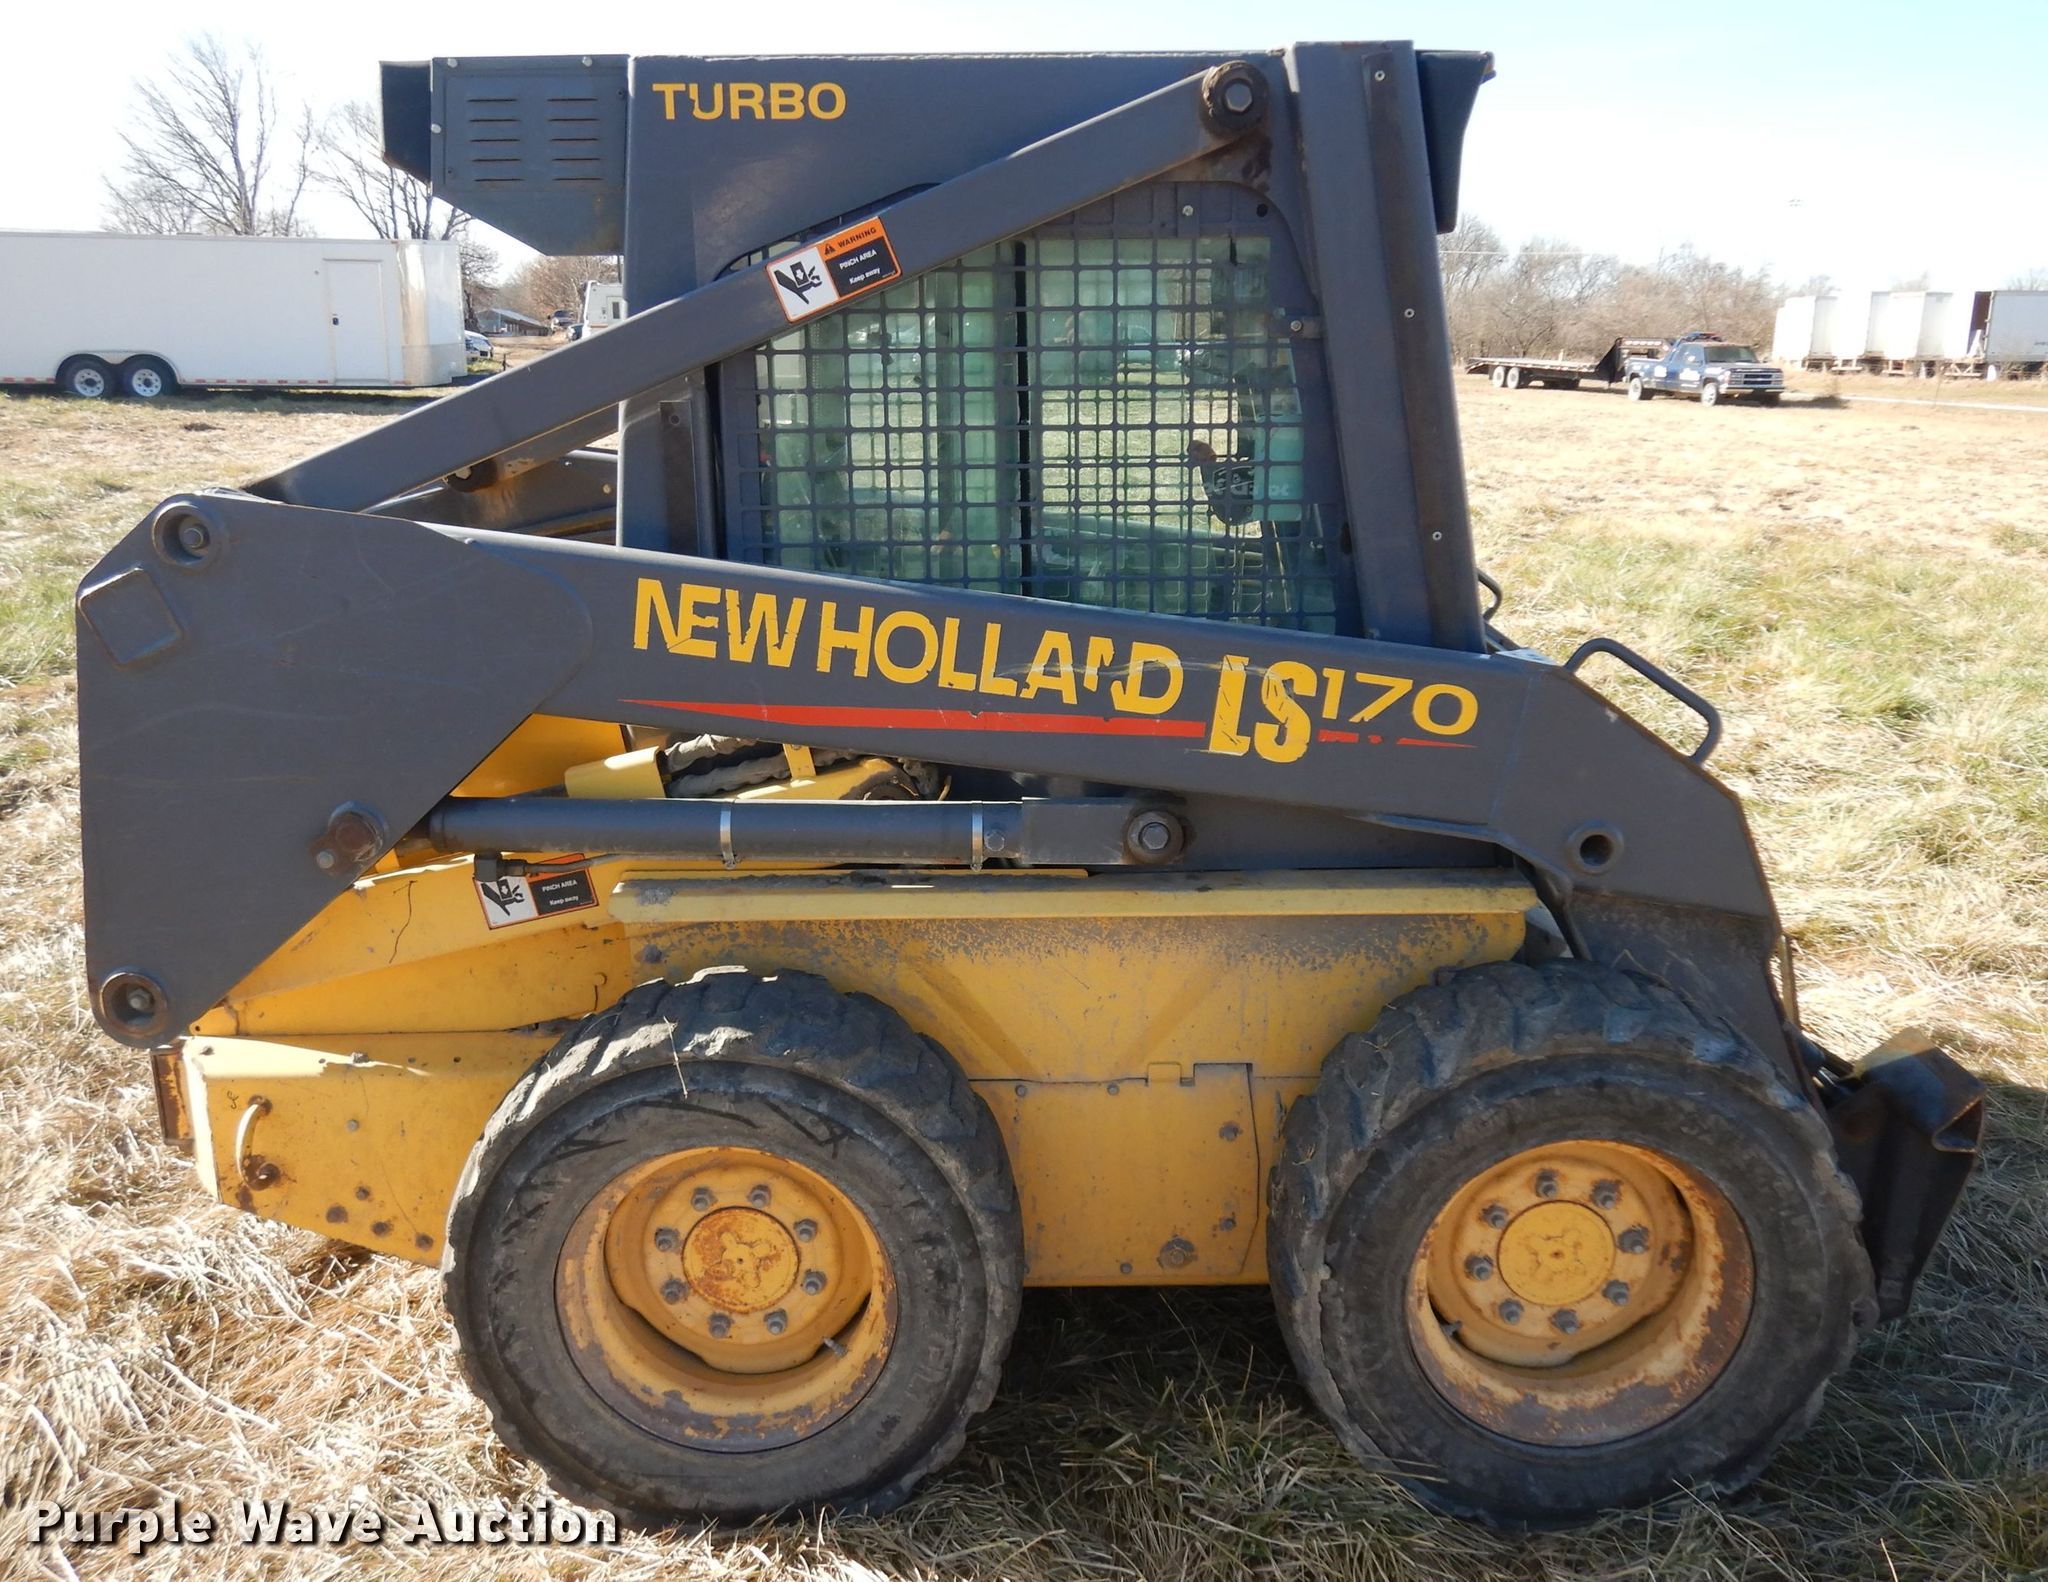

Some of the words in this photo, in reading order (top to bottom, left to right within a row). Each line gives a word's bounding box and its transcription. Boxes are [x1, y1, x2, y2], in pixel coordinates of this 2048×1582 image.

[652, 82, 846, 120] TURBO
[838, 227, 877, 248] WARNING
[839, 256, 859, 270] PINCH
[859, 249, 877, 261] AREA
[849, 275, 865, 284] Keep
[865, 267, 880, 278] away
[633, 577, 807, 668] NEW
[542, 883, 560, 892] PINCH
[561, 880, 577, 888] AREA
